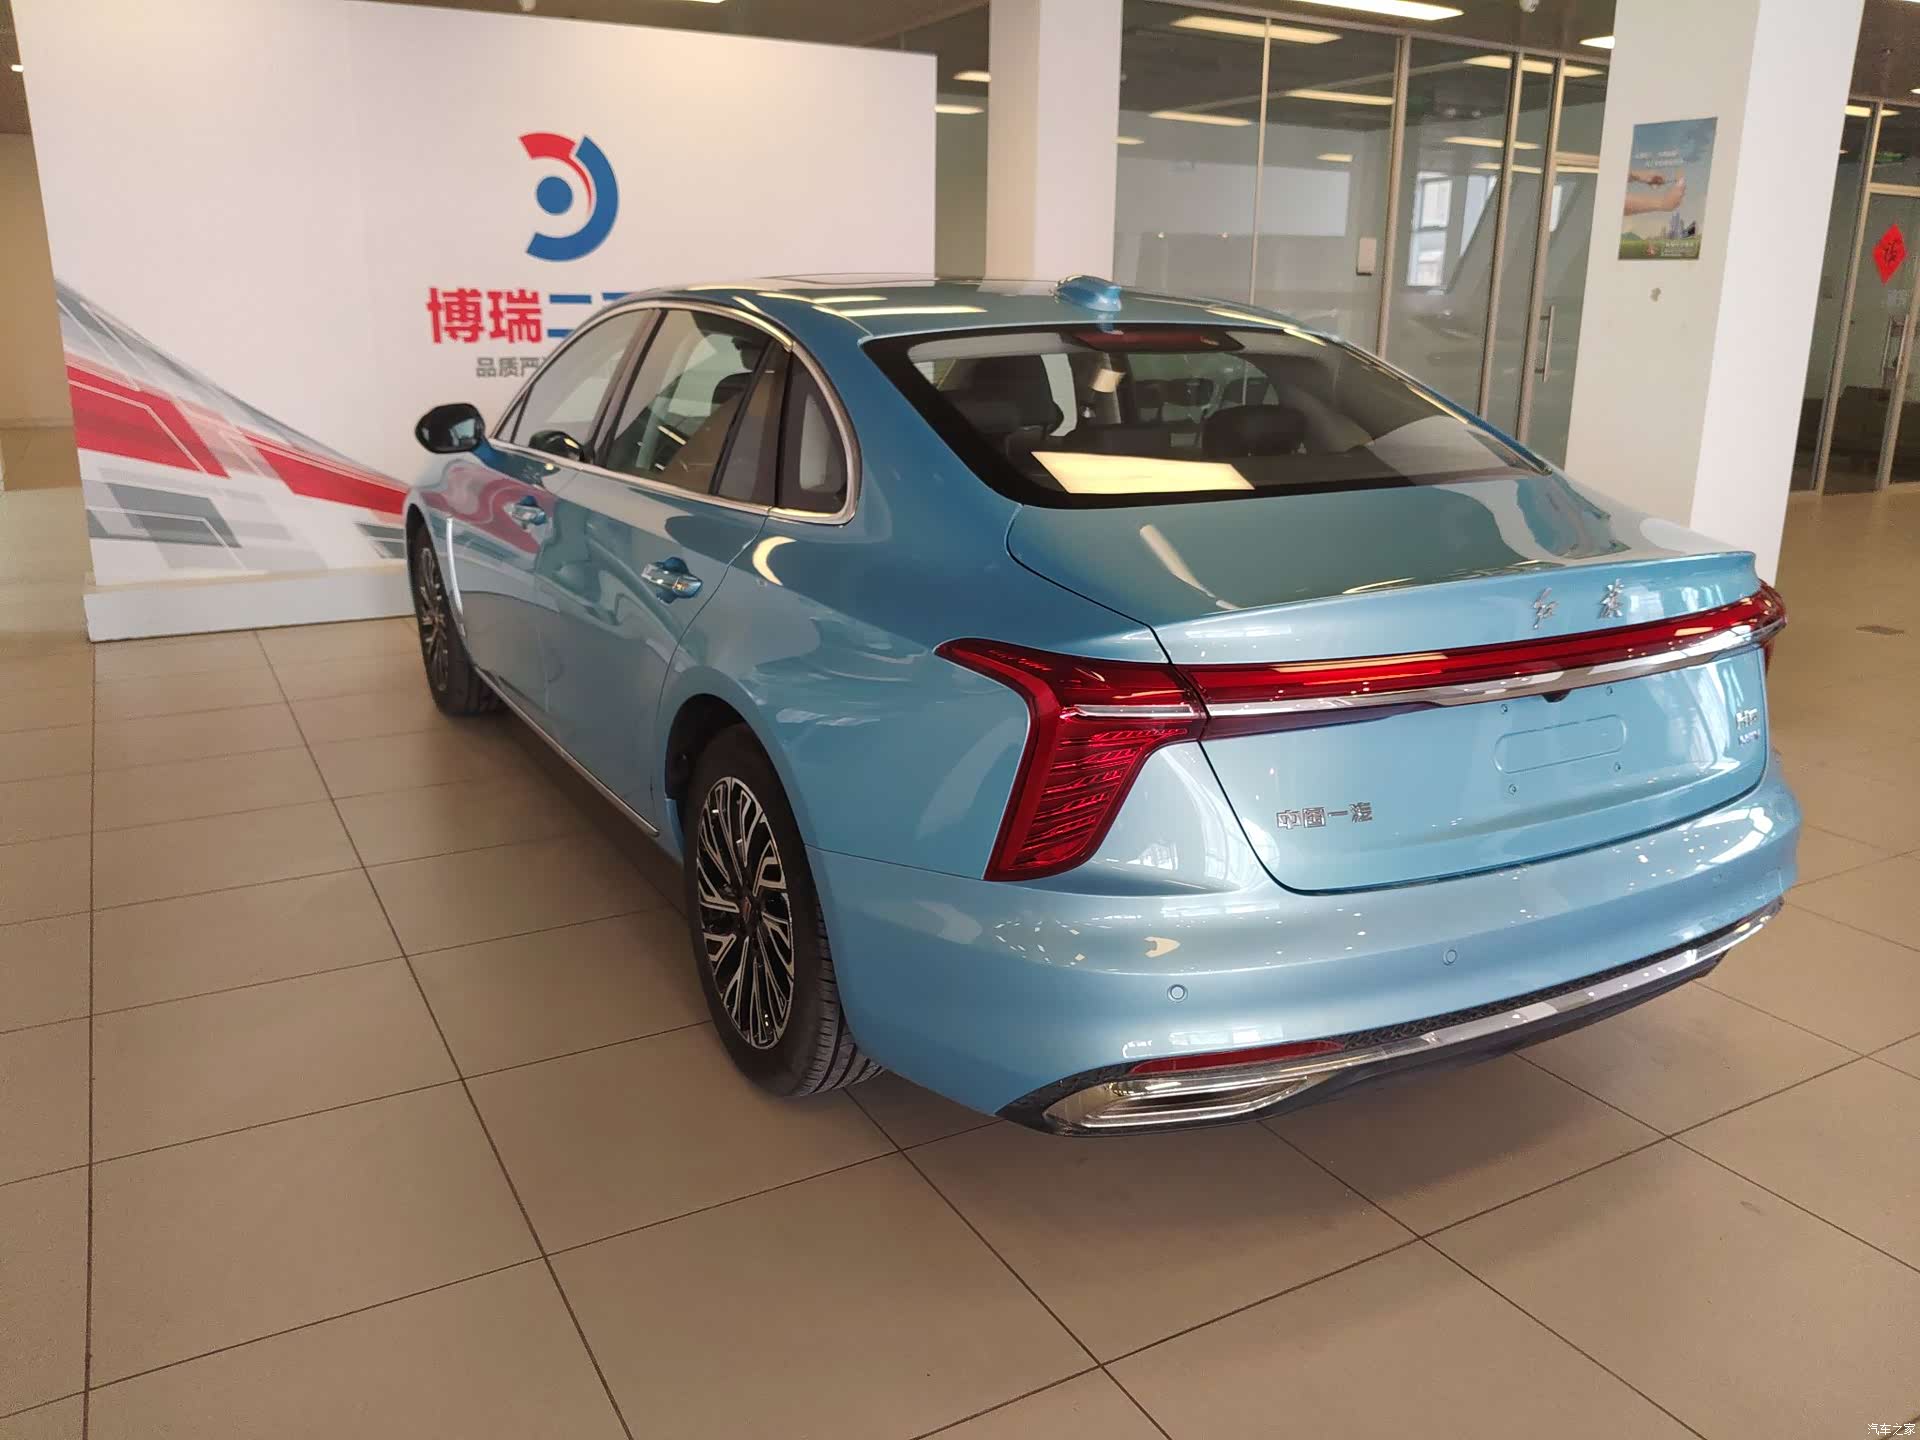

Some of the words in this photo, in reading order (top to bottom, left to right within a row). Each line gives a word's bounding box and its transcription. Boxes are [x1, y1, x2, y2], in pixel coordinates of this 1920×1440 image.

[426, 286, 632, 344] 博瑞二
[476, 355, 549, 378] 品质严
